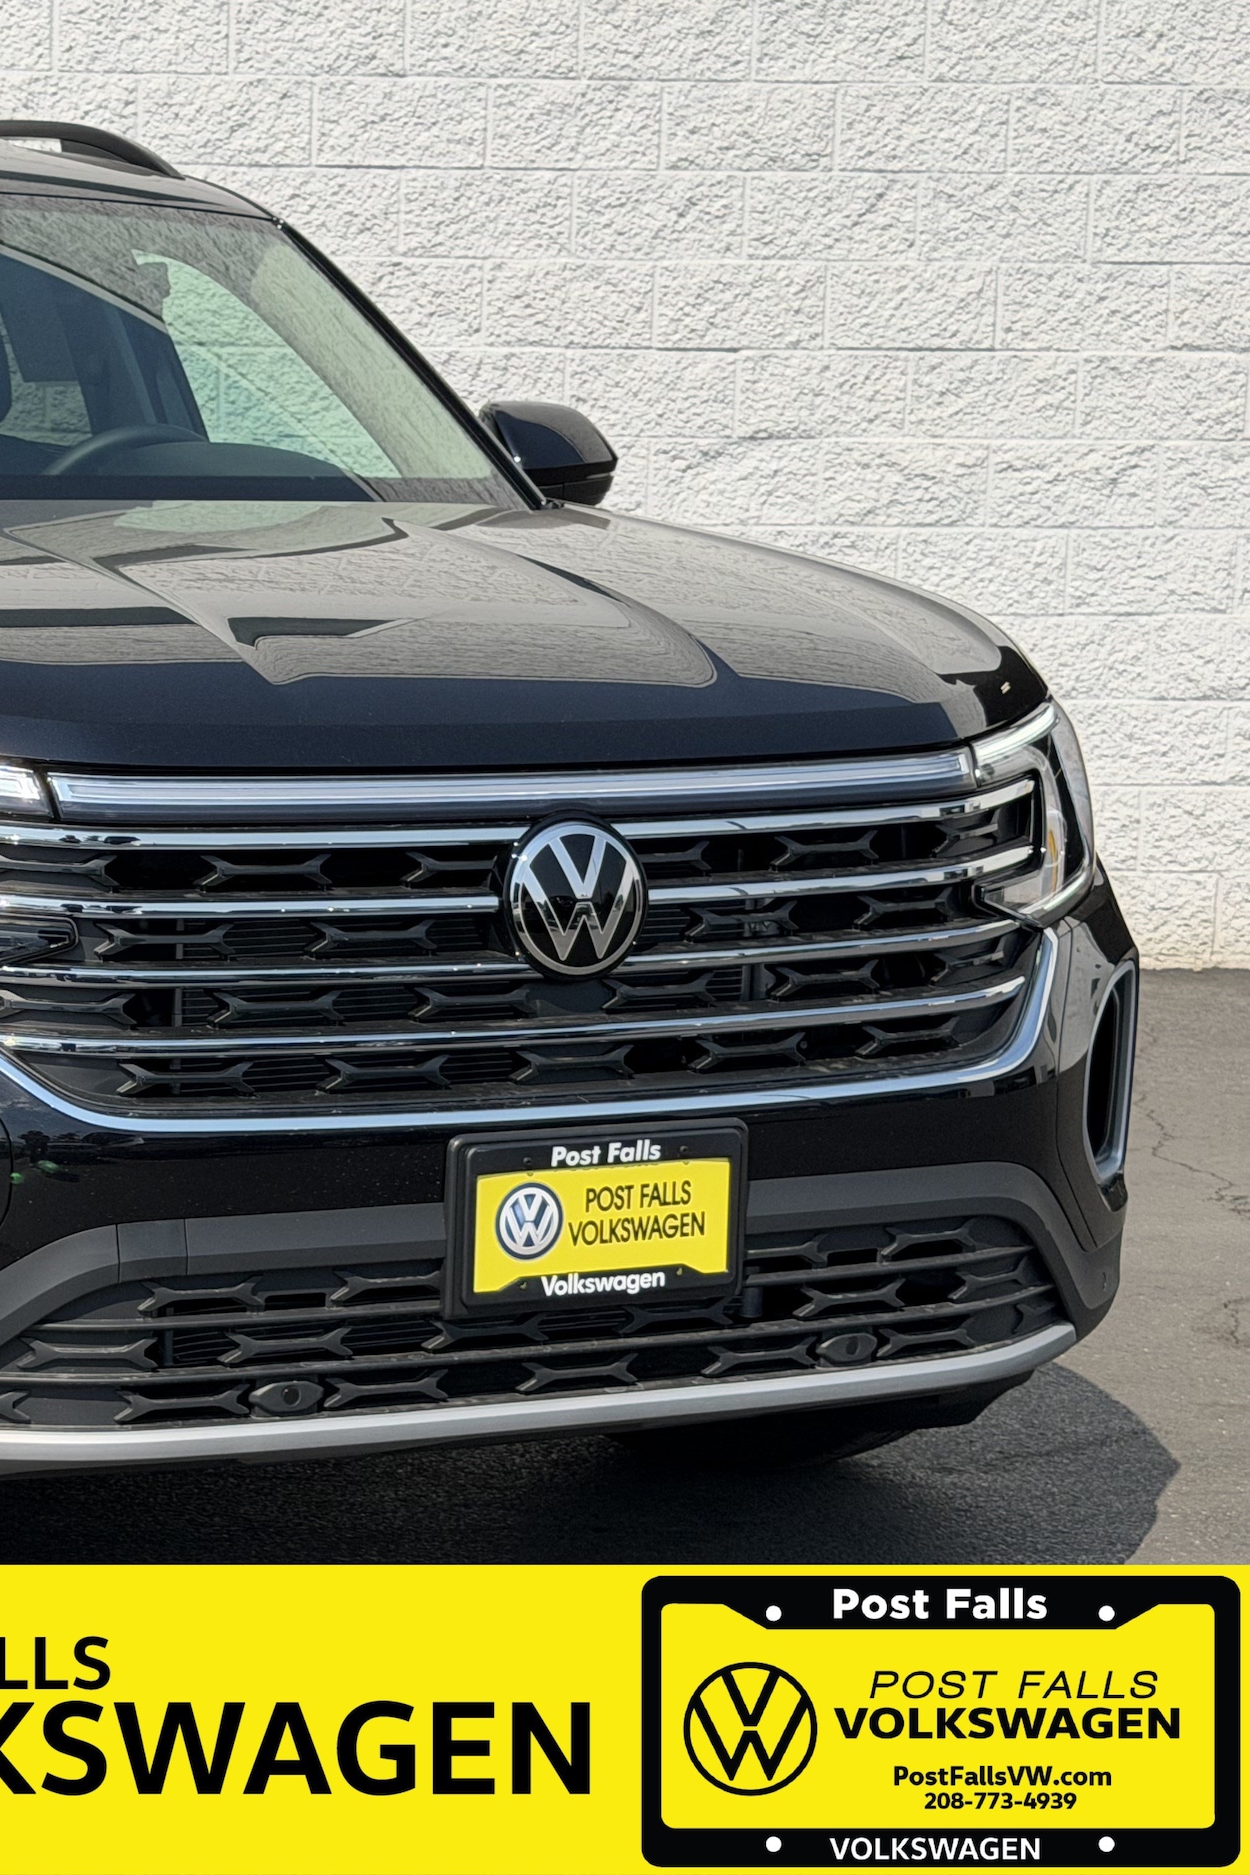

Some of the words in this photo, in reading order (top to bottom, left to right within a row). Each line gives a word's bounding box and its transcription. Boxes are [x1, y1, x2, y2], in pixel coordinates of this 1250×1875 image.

[514, 825, 640, 970] VW
[551, 1145, 601, 1167] Post
[607, 1139, 661, 1163] Falls
[585, 1185, 634, 1212] POST
[640, 1180, 691, 1208] FALLS
[569, 1211, 706, 1246] VOLKSWAGEN
[541, 1271, 665, 1297] Volkswagen
